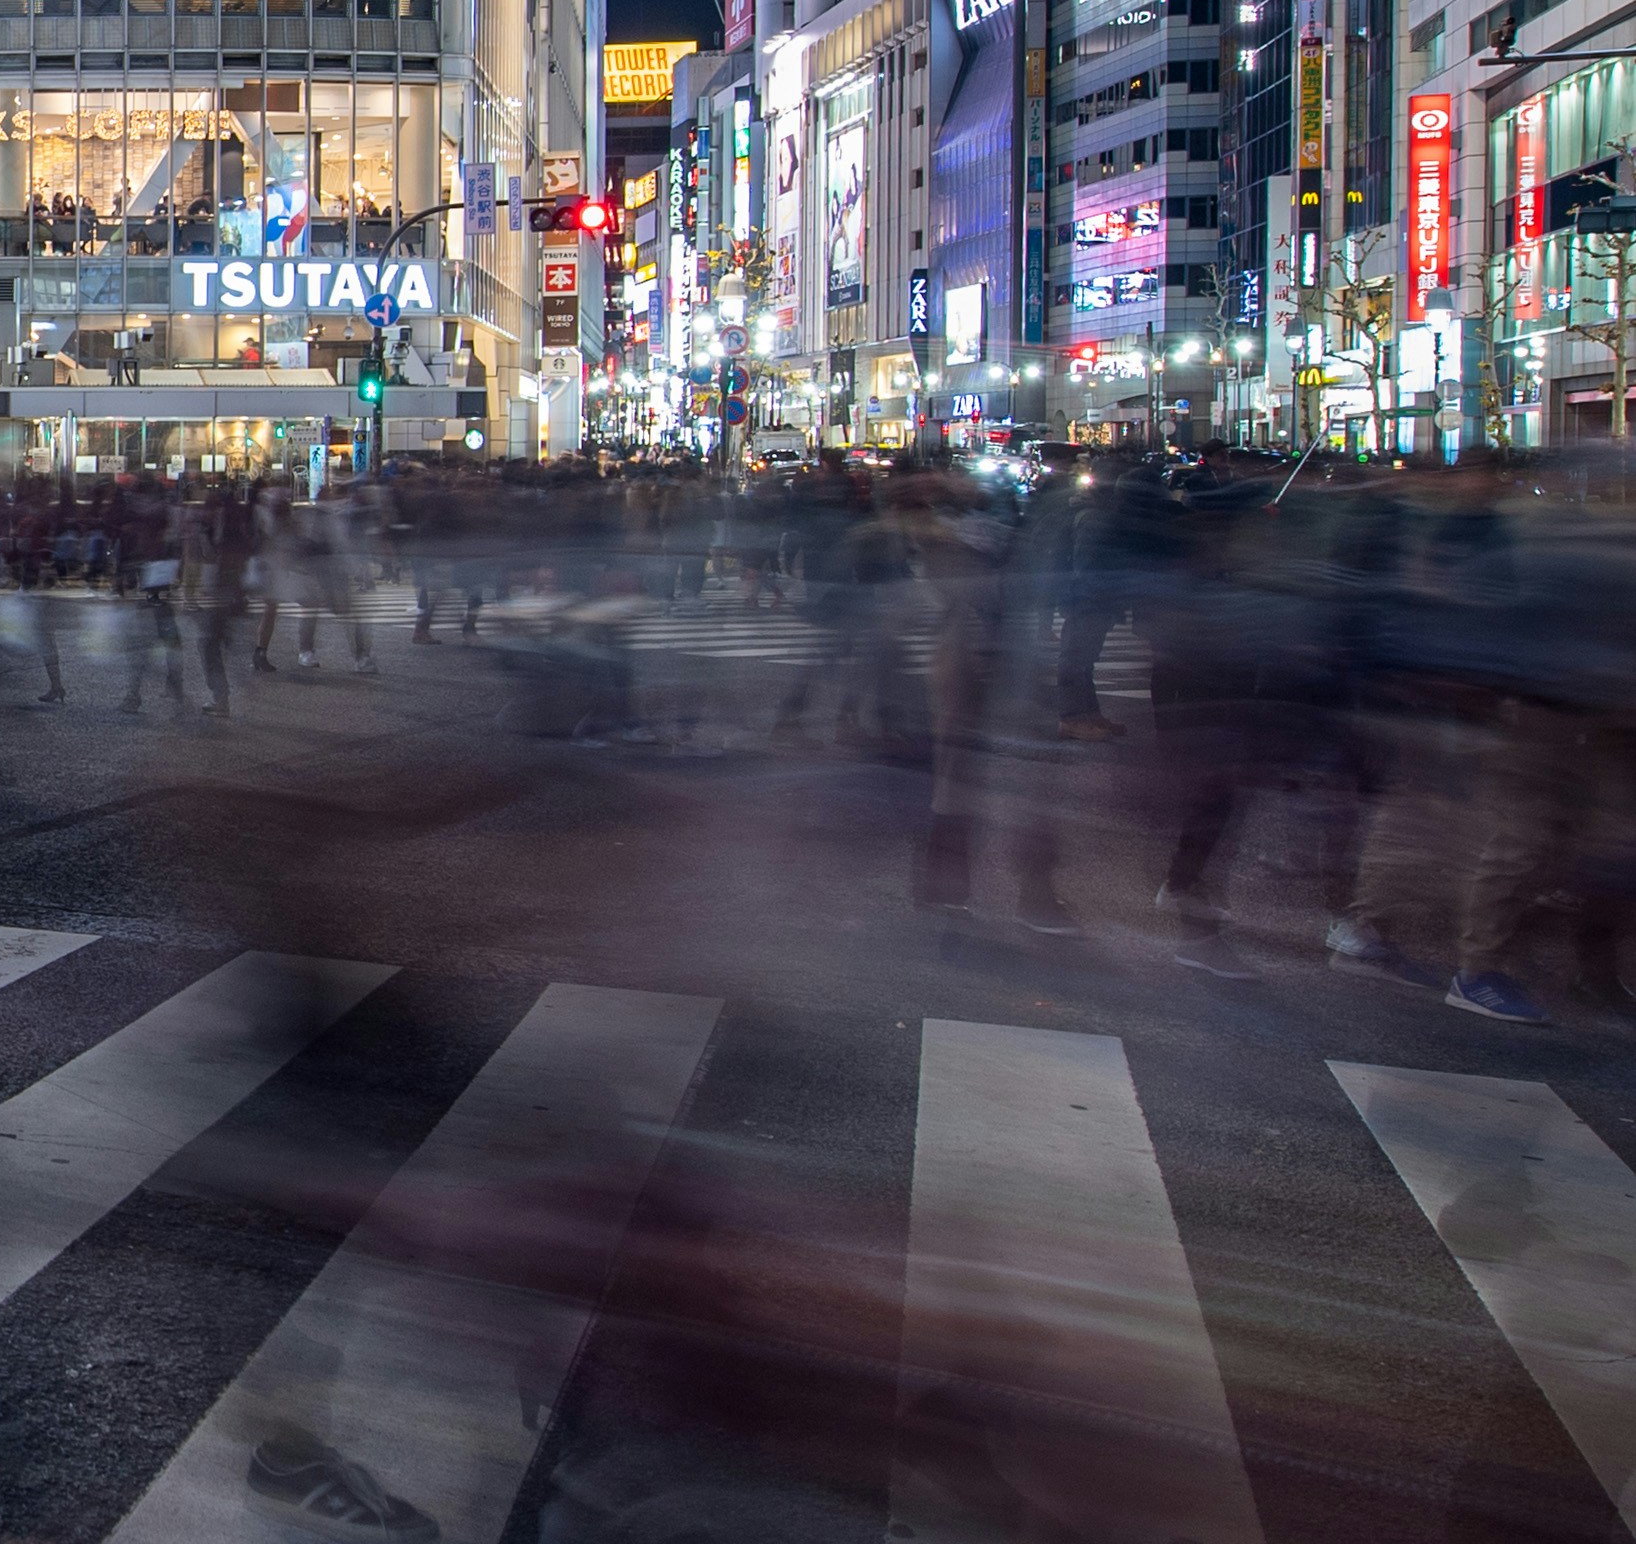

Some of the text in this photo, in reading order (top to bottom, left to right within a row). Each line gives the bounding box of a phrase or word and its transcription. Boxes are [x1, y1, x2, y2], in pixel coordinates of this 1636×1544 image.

[605, 47, 670, 73] TOWER
[604, 72, 674, 99] ECORD
[64, 108, 232, 142] COFFEE
[476, 168, 493, 230] 渋谷駅前
[669, 146, 684, 230] KARAOKE
[182, 262, 434, 309] TSUTAYA
[548, 266, 573, 290] 本
[546, 314, 575, 323] WIRED
[911, 278, 927, 334] ZARA
[952, 394, 980, 417] ZARA
